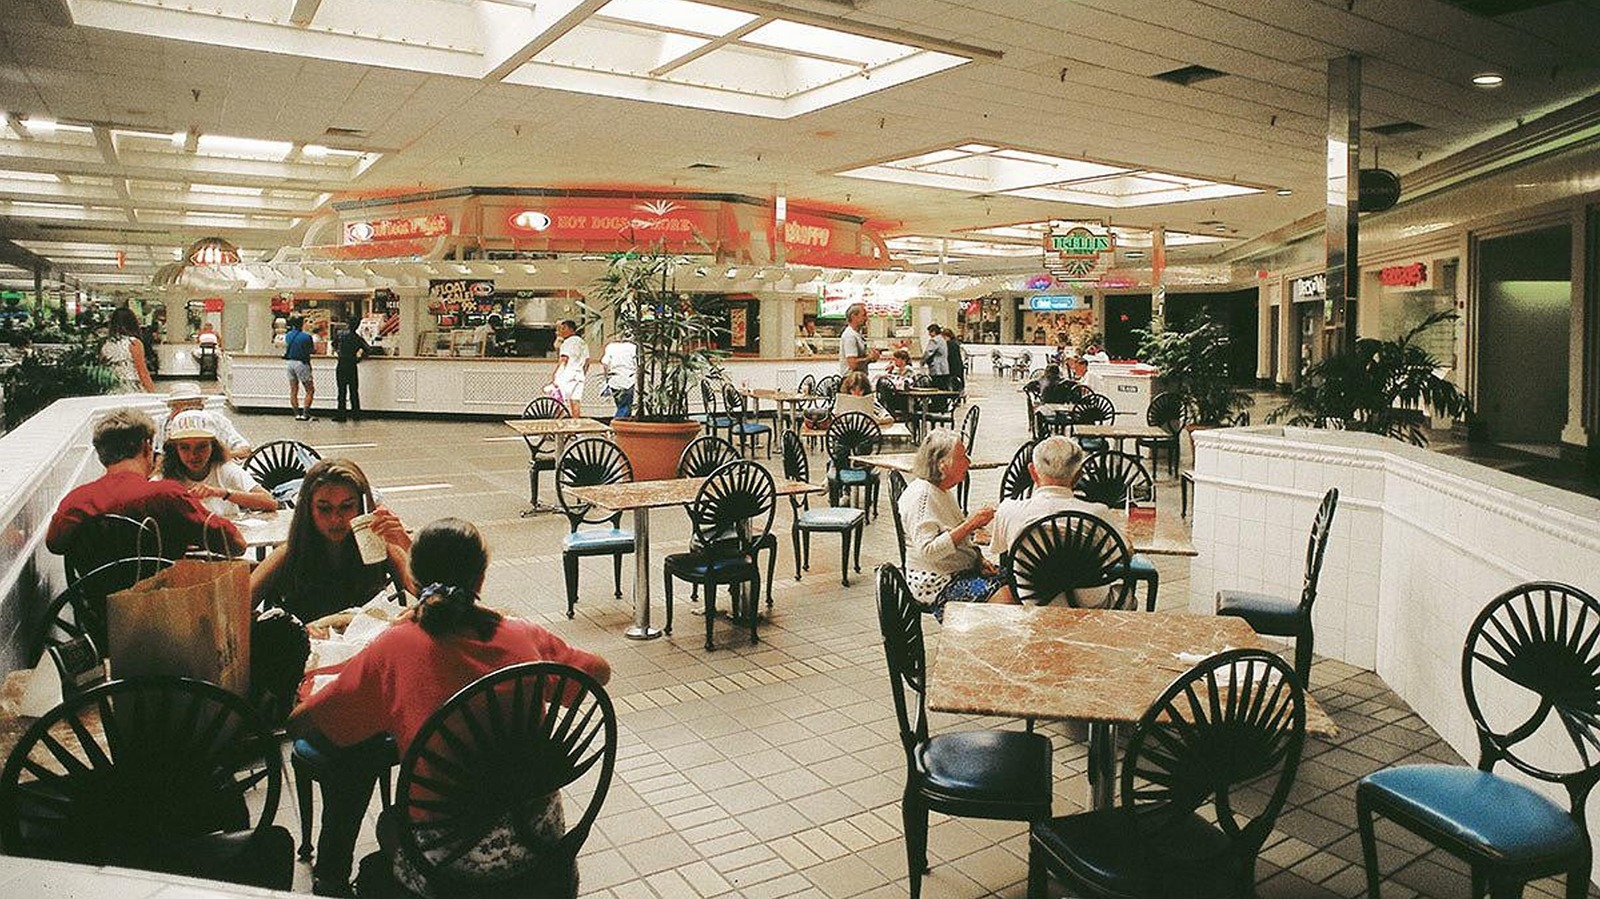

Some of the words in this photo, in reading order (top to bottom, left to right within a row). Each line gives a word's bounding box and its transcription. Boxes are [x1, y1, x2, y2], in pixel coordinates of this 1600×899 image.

[557, 216, 587, 229] HOT
[591, 216, 628, 229] DOGS
[434, 280, 467, 298] FLOAT
